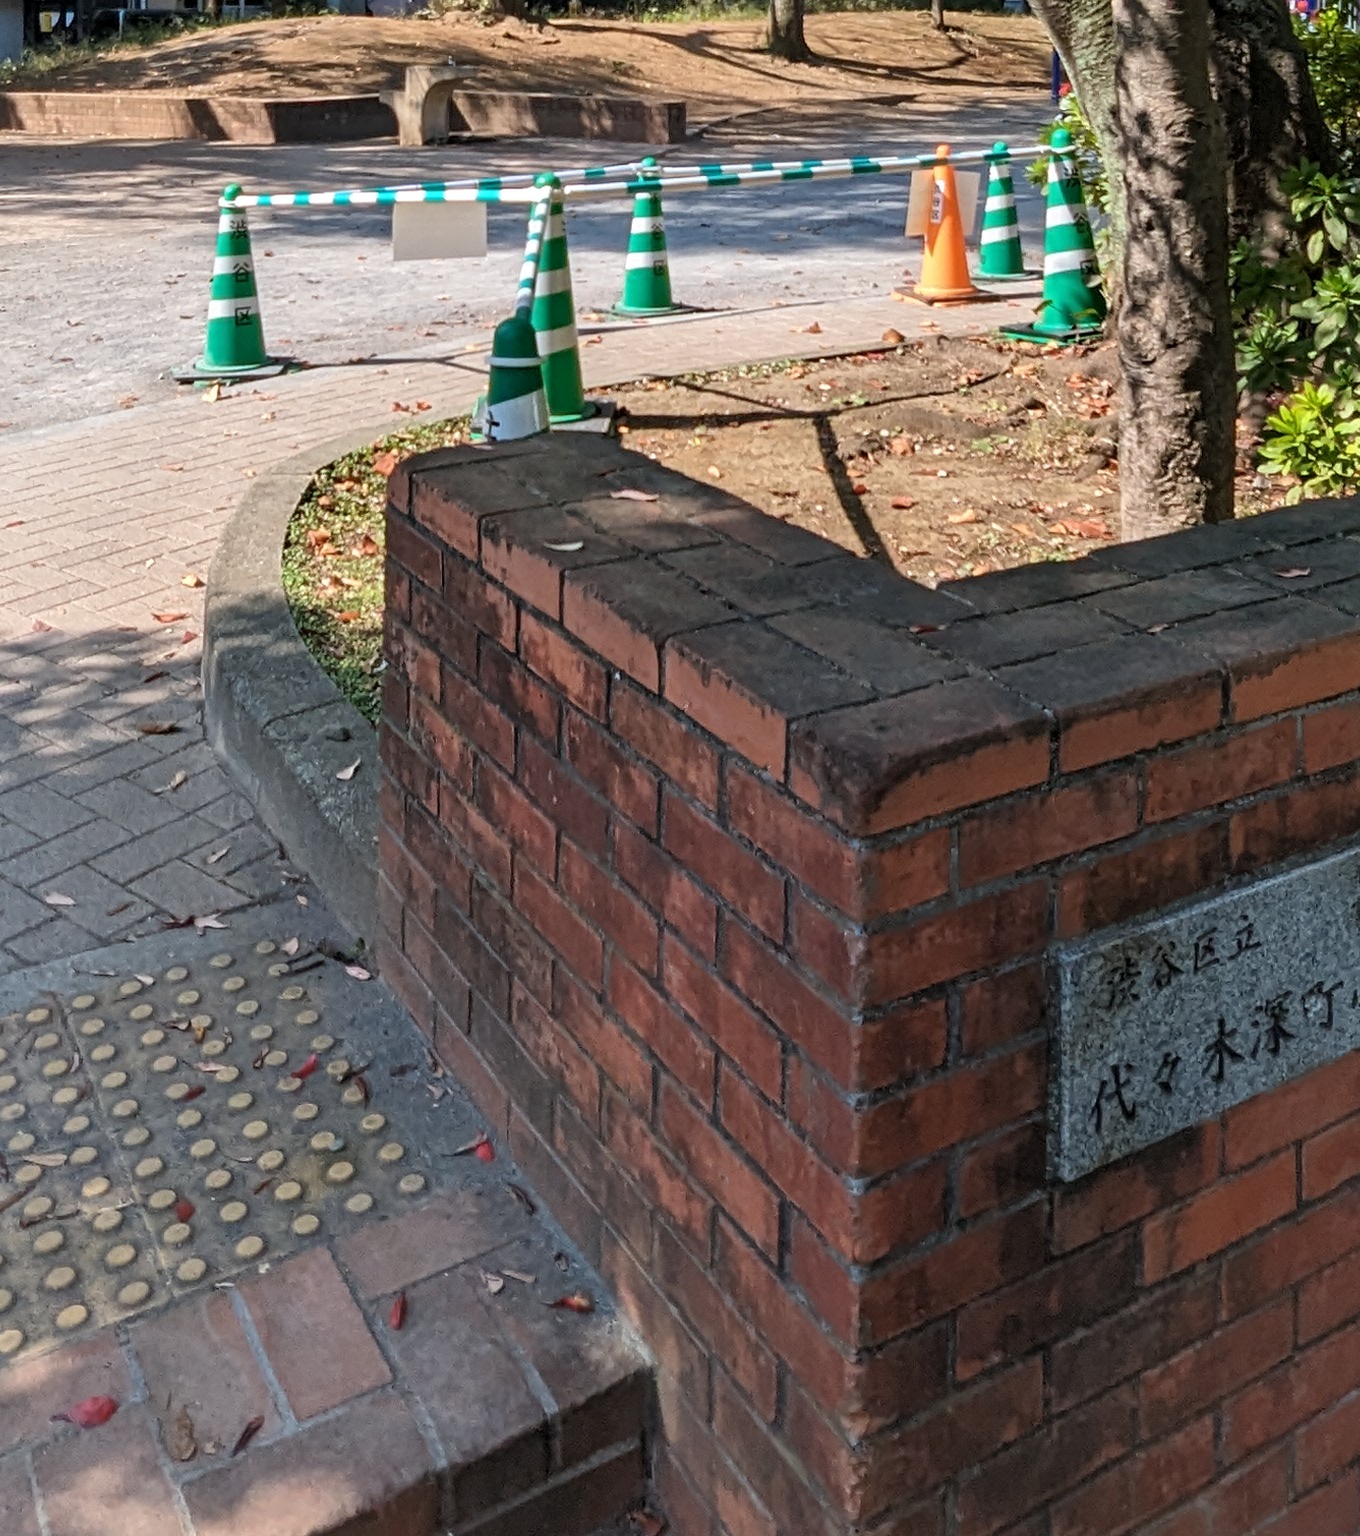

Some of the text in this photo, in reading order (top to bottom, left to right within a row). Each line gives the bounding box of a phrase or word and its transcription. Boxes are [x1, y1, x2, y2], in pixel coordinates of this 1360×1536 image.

[229, 219, 253, 327] 渋谷区
[1103, 914, 1262, 1010] 渋谷区立
